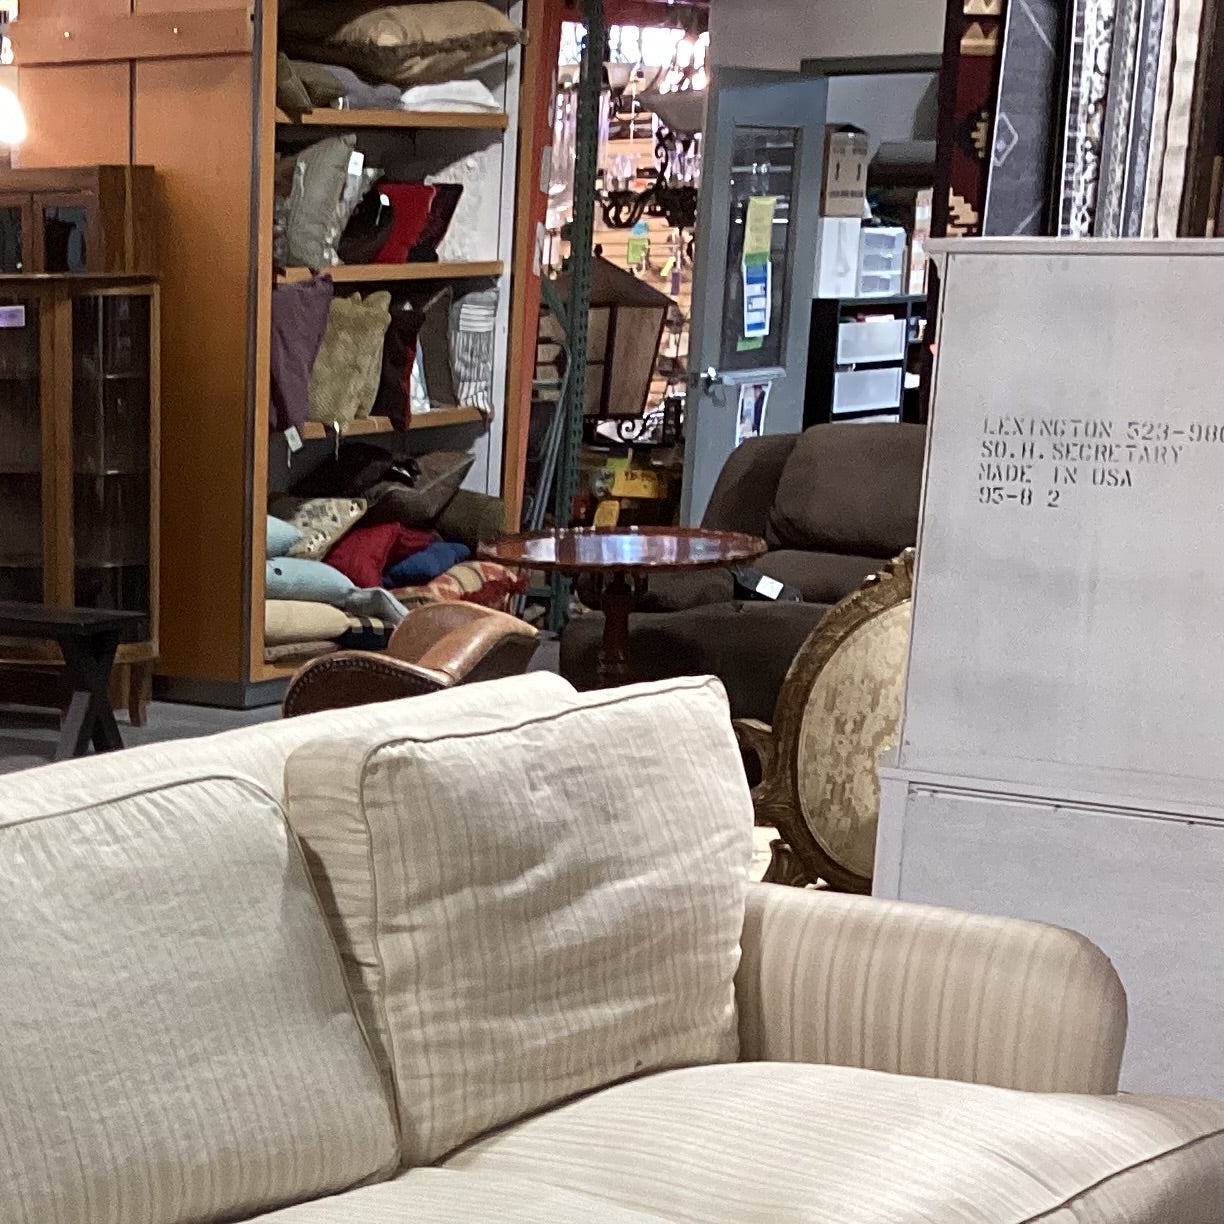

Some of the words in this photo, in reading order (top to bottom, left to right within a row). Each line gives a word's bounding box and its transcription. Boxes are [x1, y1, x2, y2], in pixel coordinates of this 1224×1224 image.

[982, 416, 1112, 438] LEXINGTON
[978, 464, 1032, 483] MADE
[1054, 466, 1076, 484] IN
[1092, 469, 1133, 487] USA
